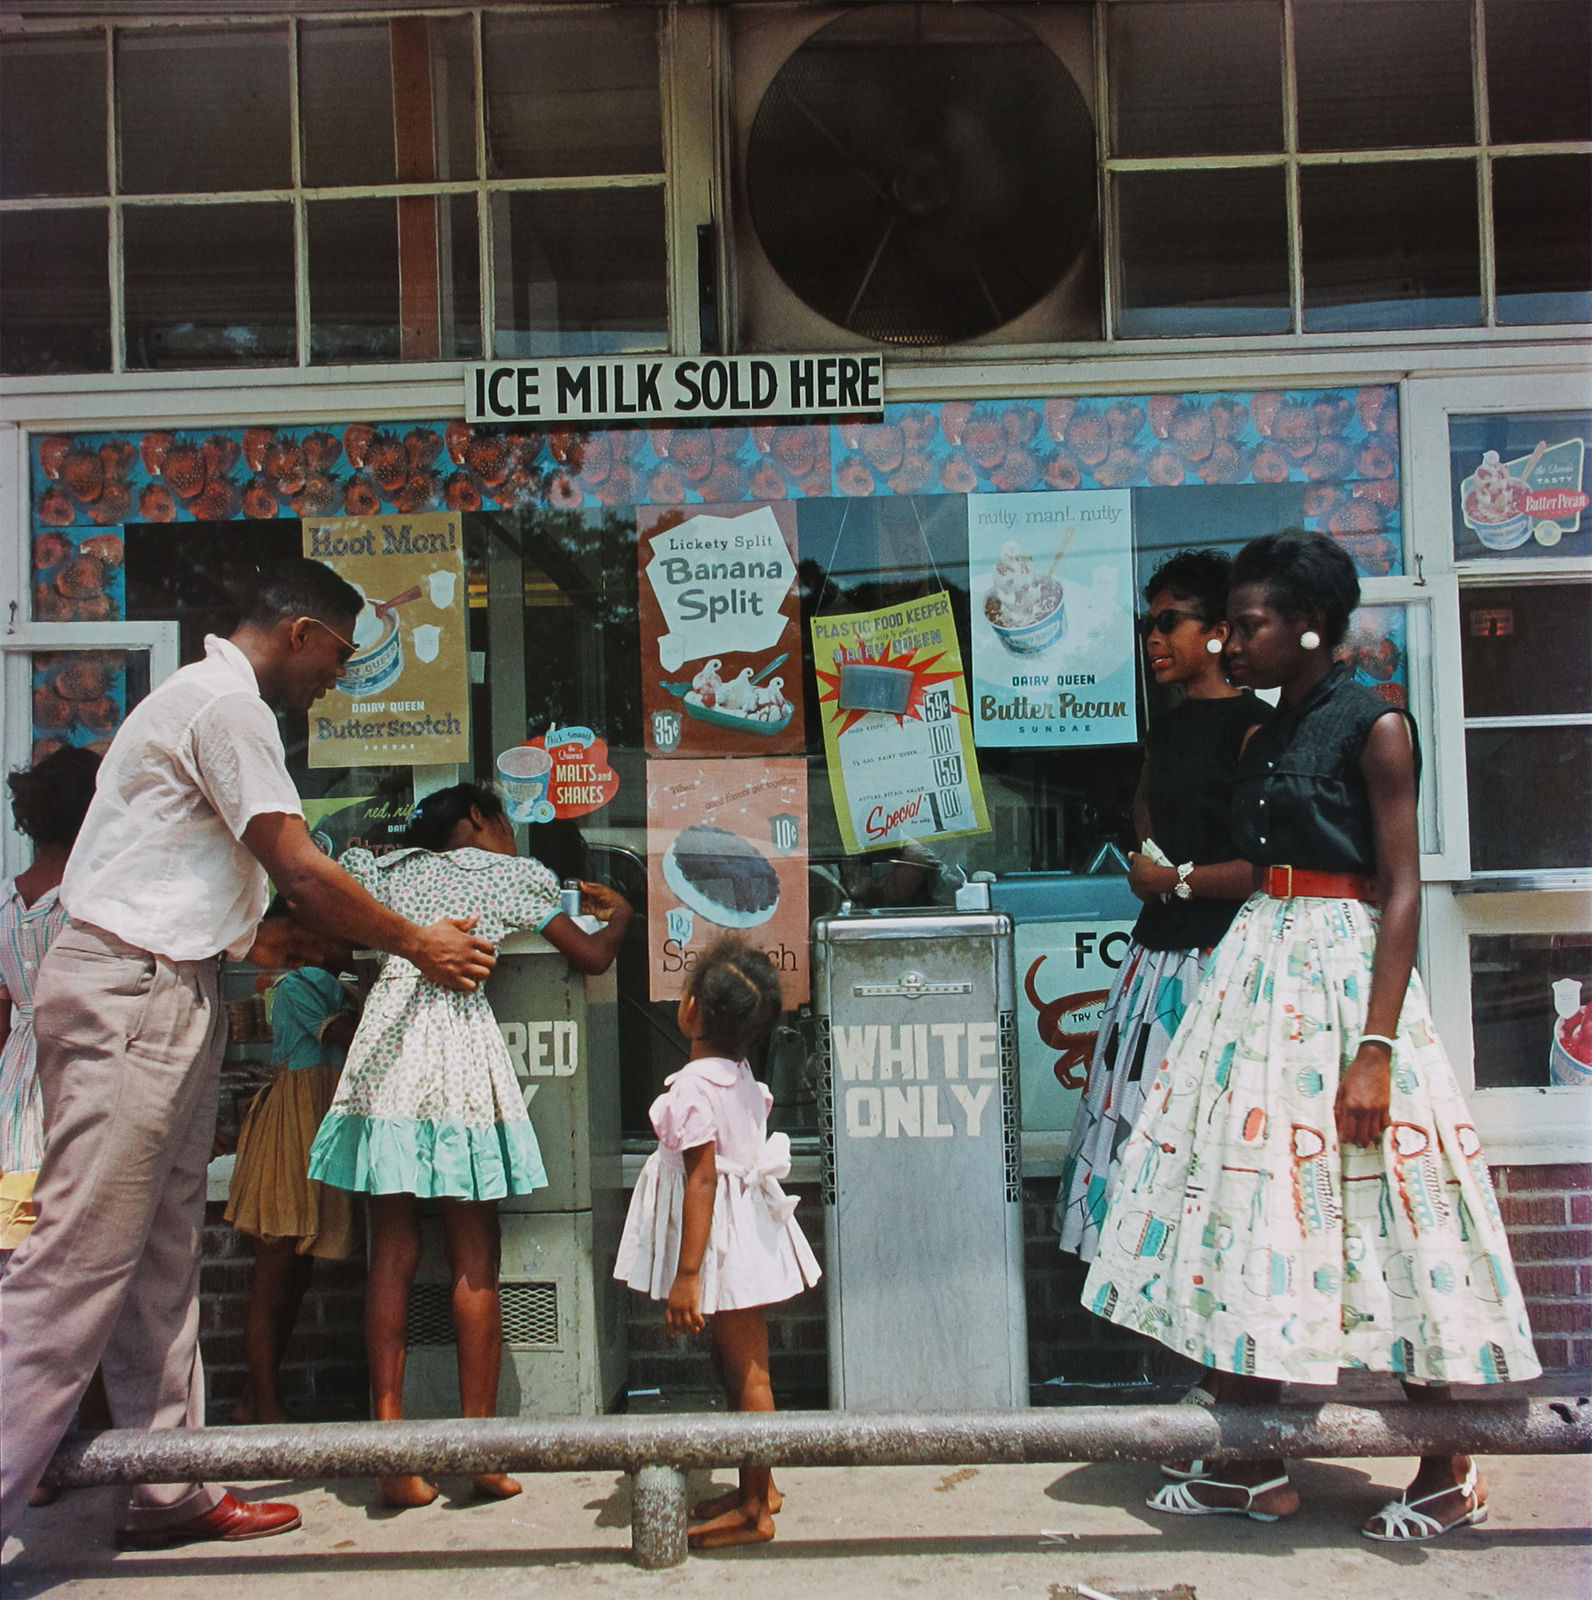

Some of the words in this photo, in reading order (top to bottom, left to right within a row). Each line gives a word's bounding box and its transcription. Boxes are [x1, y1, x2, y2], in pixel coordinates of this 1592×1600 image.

[476, 367, 540, 417] ICE
[556, 364, 662, 414] MILK
[674, 360, 777, 411] SOLD
[790, 358, 881, 409] HERE
[1080, 504, 1123, 524] nutty
[1526, 496, 1557, 512] Butter
[1558, 493, 1585, 509] Pecan
[309, 527, 376, 557] Hoot
[382, 522, 457, 555] Mon!
[669, 538, 728, 551] Lickety
[734, 535, 773, 549] Split
[659, 557, 782, 585] Banana
[677, 588, 764, 623] Split
[815, 619, 871, 639] PLASTIC
[874, 612, 903, 631] FOOD
[906, 600, 950, 624] KEEPER
[832, 643, 886, 664] DAIRY
[892, 629, 942, 654] QUEEN
[1012, 676, 1049, 687] DAIRY
[1057, 674, 1096, 686] QUEEN
[352, 702, 385, 713] DAIRY
[390, 701, 425, 713] QUEEN
[925, 691, 950, 722] 59¢
[980, 695, 1055, 721] Butter
[1059, 693, 1129, 720] Pecan
[315, 712, 461, 740] Butterscotch
[655, 715, 679, 745] 35¢
[1019, 724, 1091, 734] SUNDAE
[556, 764, 597, 783] MALTS
[597, 770, 613, 782] and
[933, 755, 963, 787] 159
[556, 785, 604, 804] SHAKES
[866, 793, 922, 841] Special
[775, 819, 797, 850] 10¢
[1072, 1012, 1091, 1024] TRY
[831, 1022, 998, 1081] WHITE
[845, 1084, 994, 1138] ONLY
